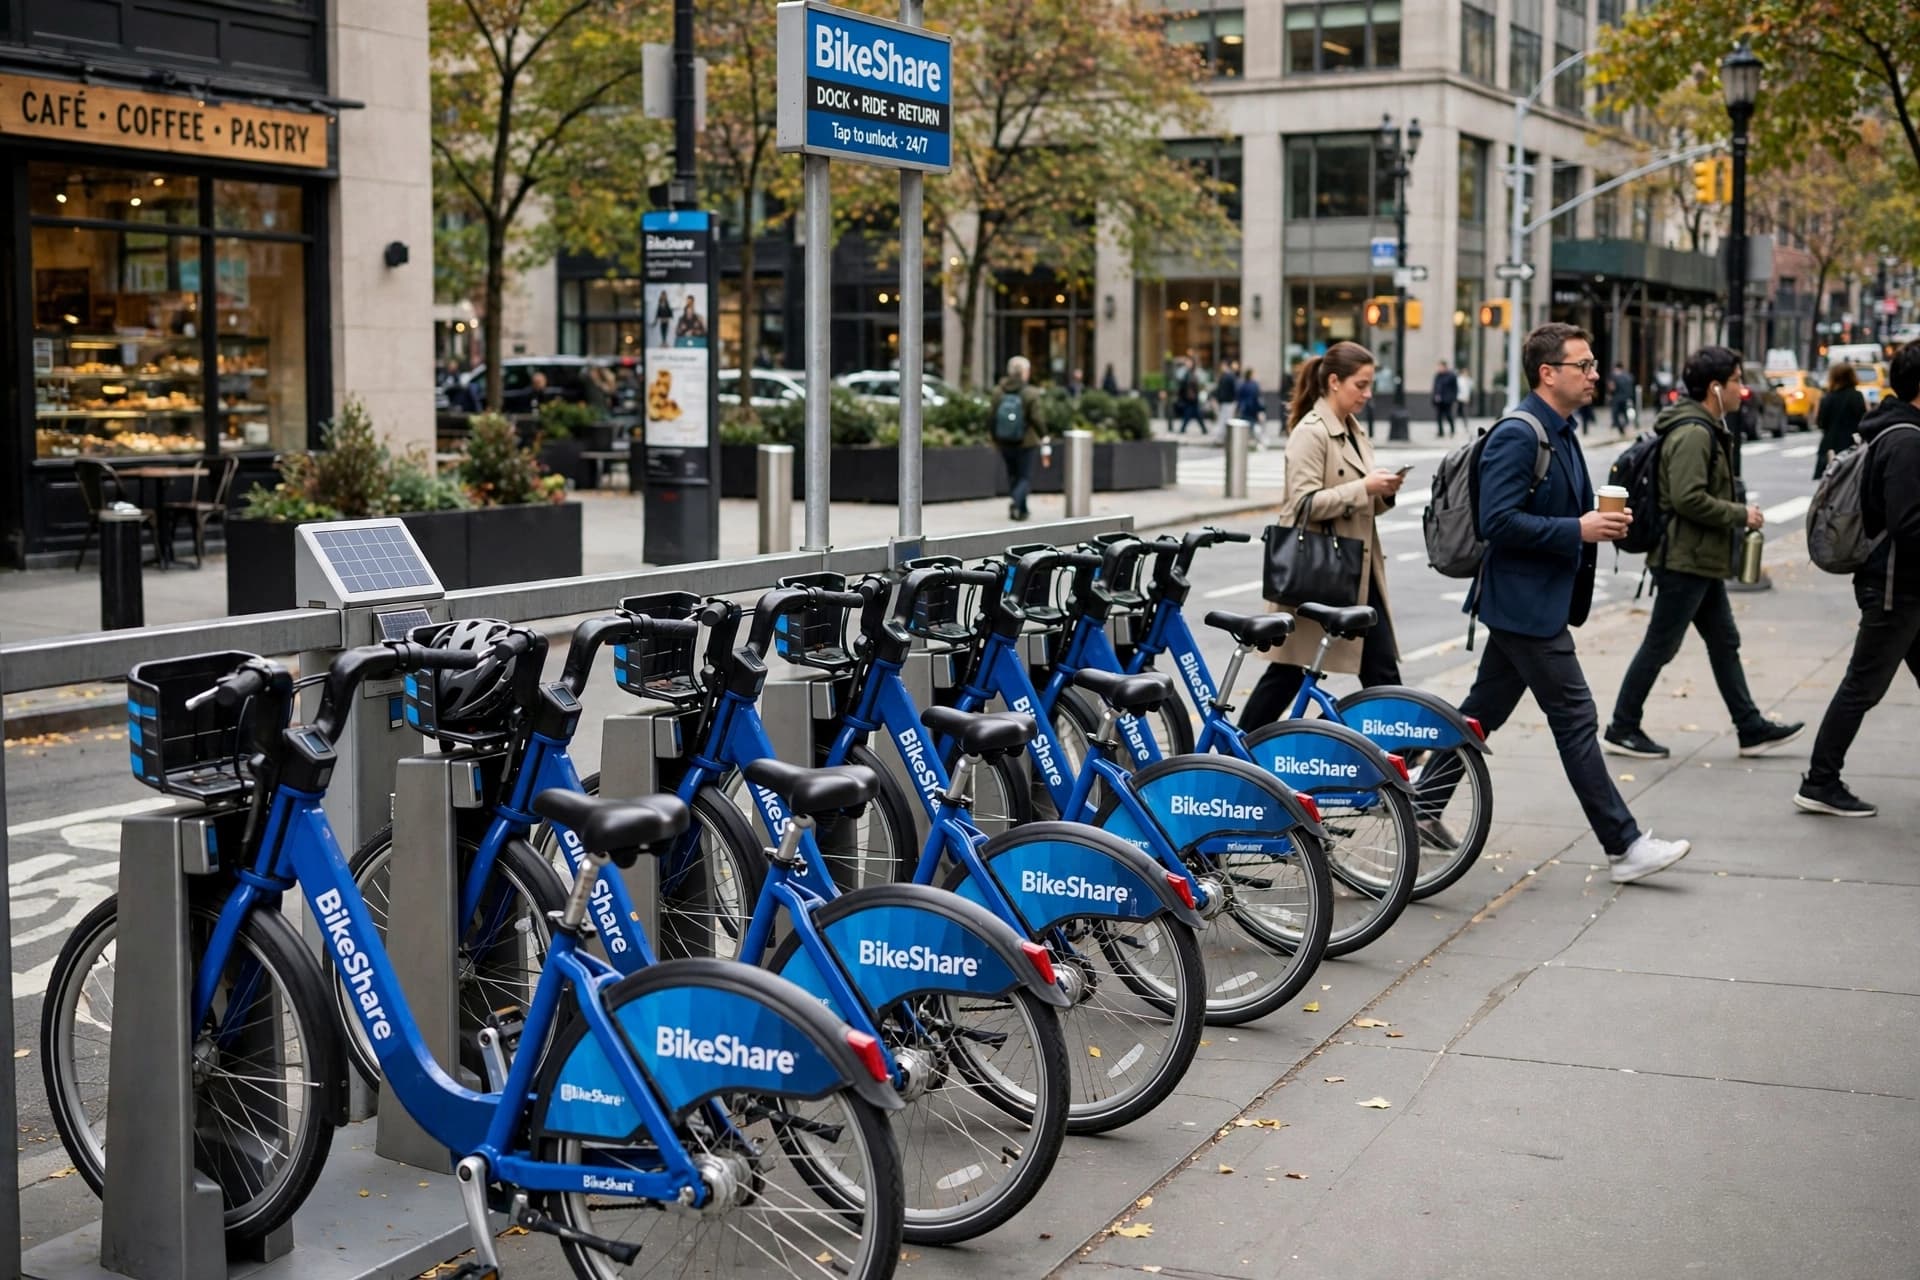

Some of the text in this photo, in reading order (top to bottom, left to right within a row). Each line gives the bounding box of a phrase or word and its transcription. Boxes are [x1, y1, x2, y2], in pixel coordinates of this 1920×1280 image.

[816, 24, 941, 92] BikeShare
[22, 91, 309, 153] CAFÉ COFFEE PASTRY
[817, 86, 940, 126] DOCK RIDE RETURN
[832, 122, 928, 154] Tap to unlock 24/7
[1362, 719, 1438, 739] BikeShare
[1274, 756, 1357, 777] BikeShare
[1171, 796, 1263, 820] BikeShare
[1022, 870, 1128, 903] BikeShare
[315, 888, 391, 1040] BikeShare
[859, 940, 977, 977] BikeShare
[656, 1026, 795, 1074] BikeShare
[583, 1174, 634, 1192] BikeShare
